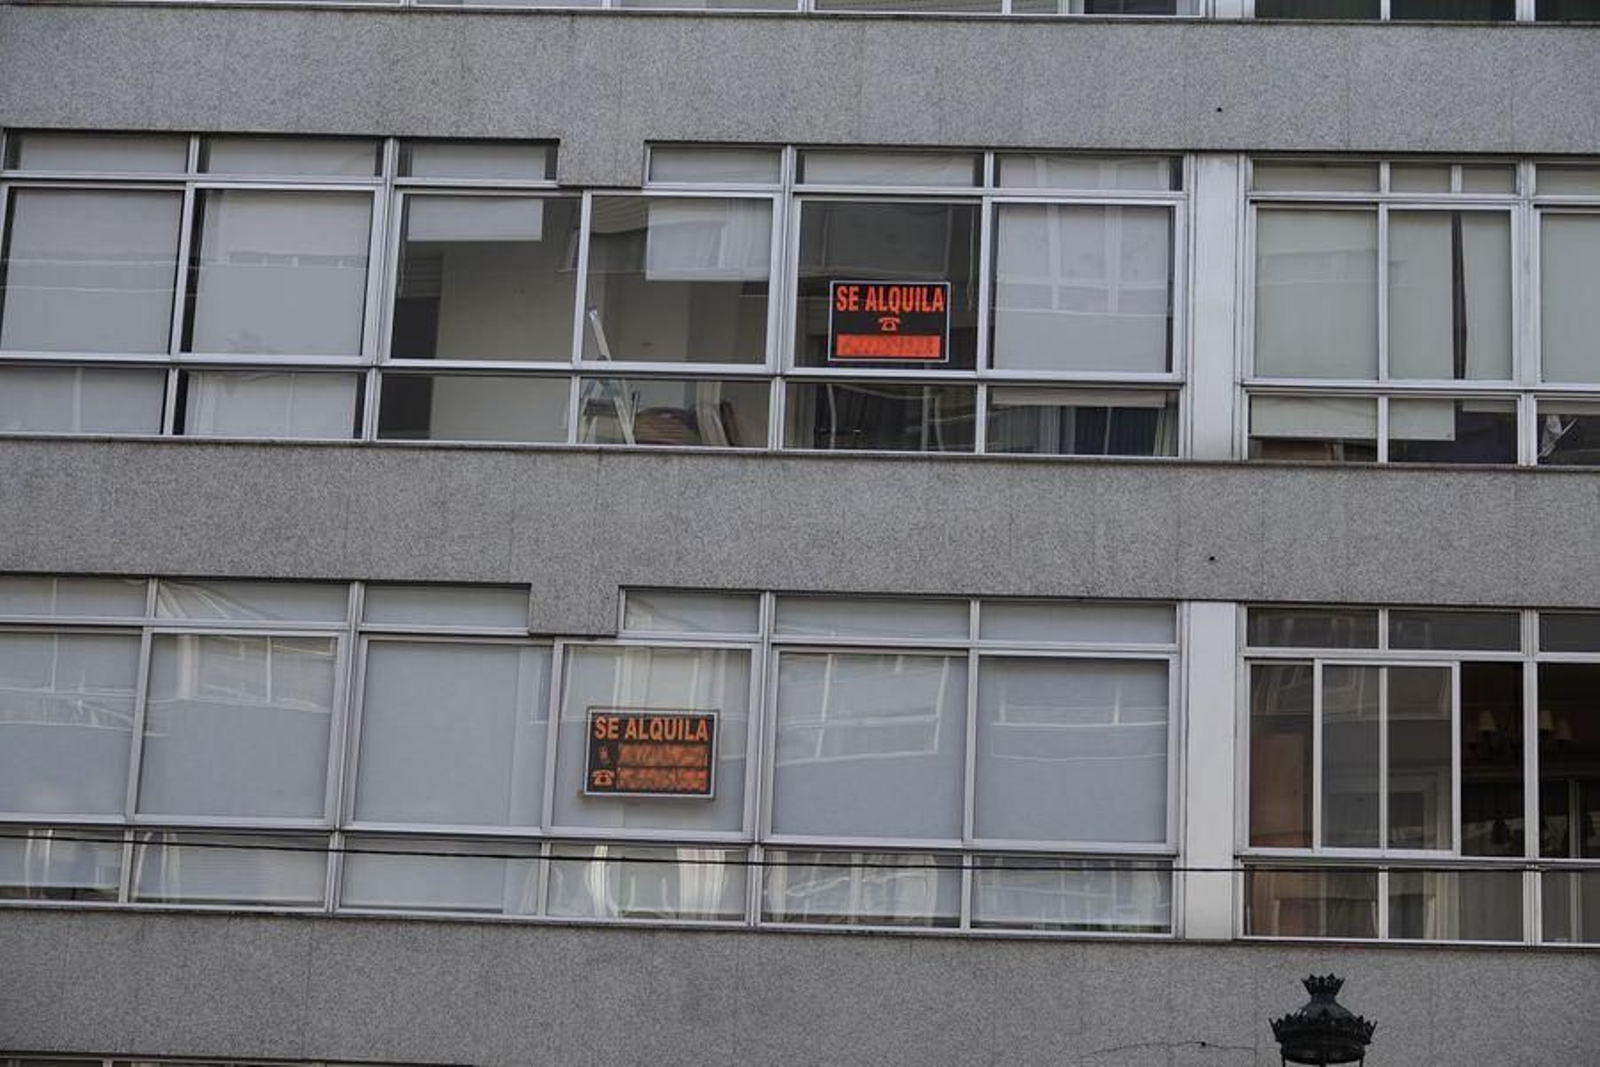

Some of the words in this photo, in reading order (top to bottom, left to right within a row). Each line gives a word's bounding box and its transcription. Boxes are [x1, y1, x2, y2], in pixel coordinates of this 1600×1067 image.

[836, 285, 859, 312] SE
[865, 286, 944, 314] ALQUILA
[595, 716, 620, 739] SE
[624, 717, 709, 741] ALQUILA
